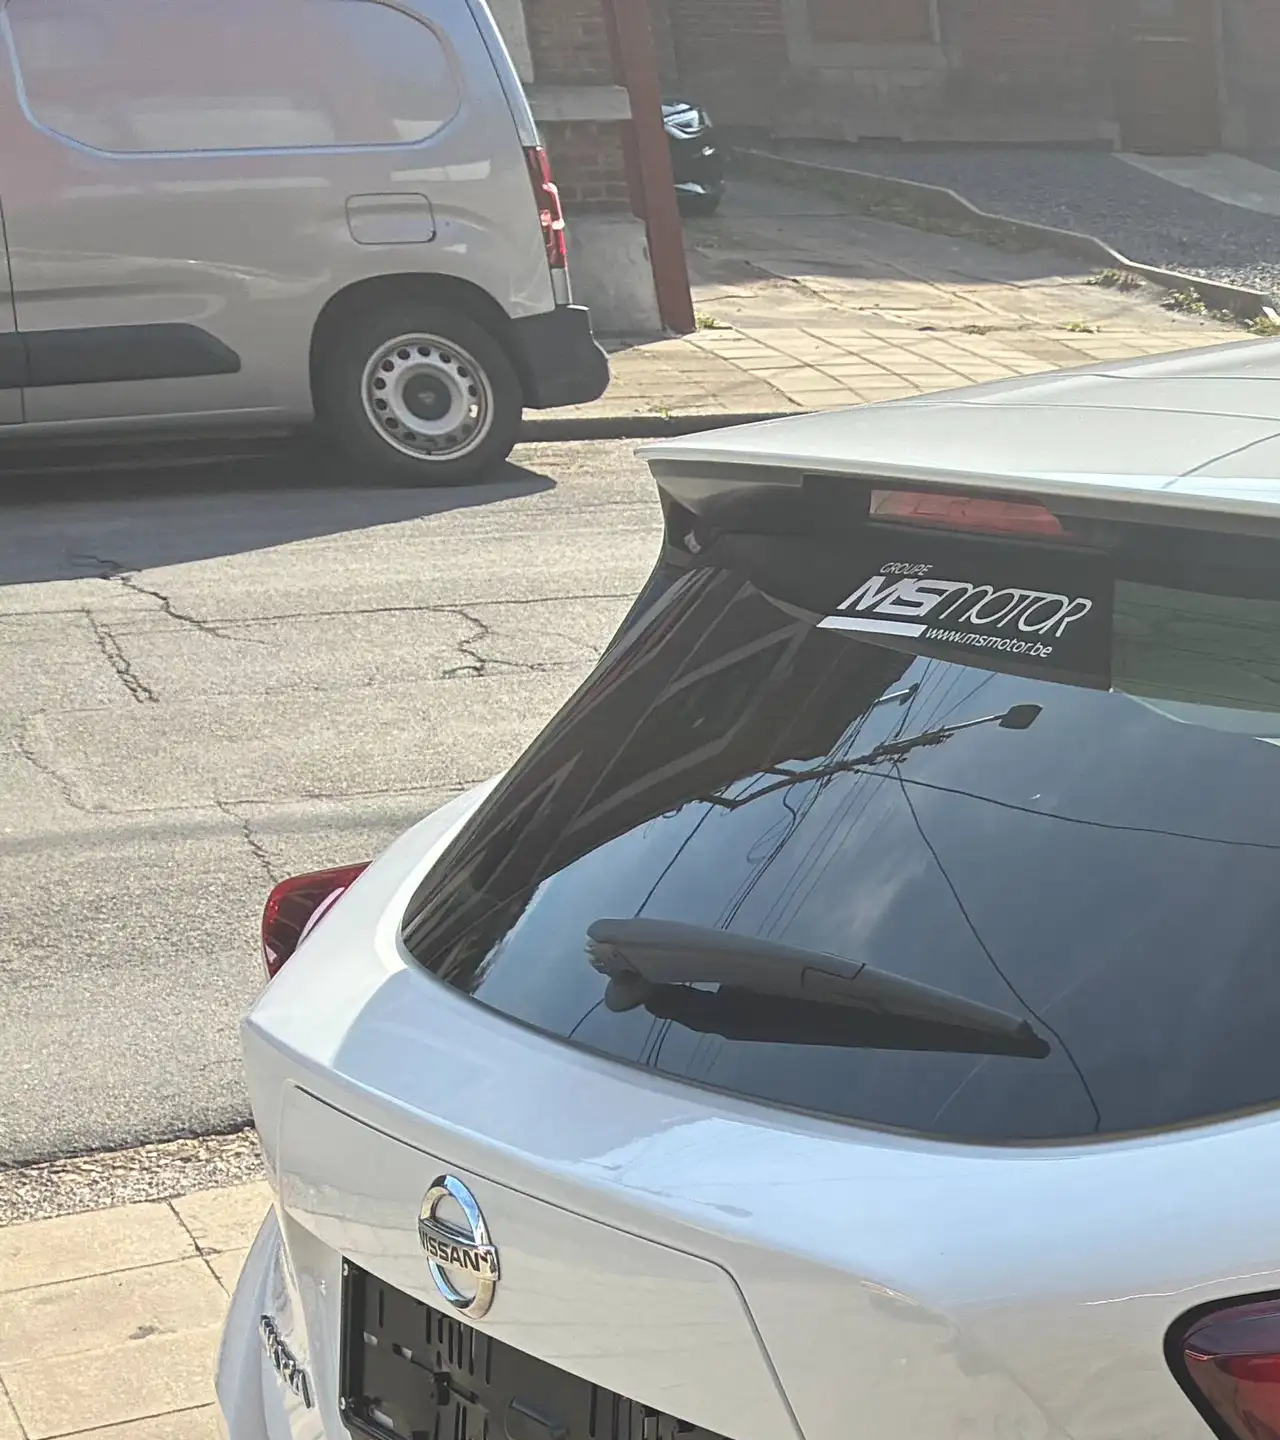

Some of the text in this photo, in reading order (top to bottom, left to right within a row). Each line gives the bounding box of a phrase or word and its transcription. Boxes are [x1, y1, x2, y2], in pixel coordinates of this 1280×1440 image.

[880, 562, 933, 575] GROUPE
[925, 627, 1053, 657] www.msmotor.be
[418, 1226, 481, 1272] NISSAN
